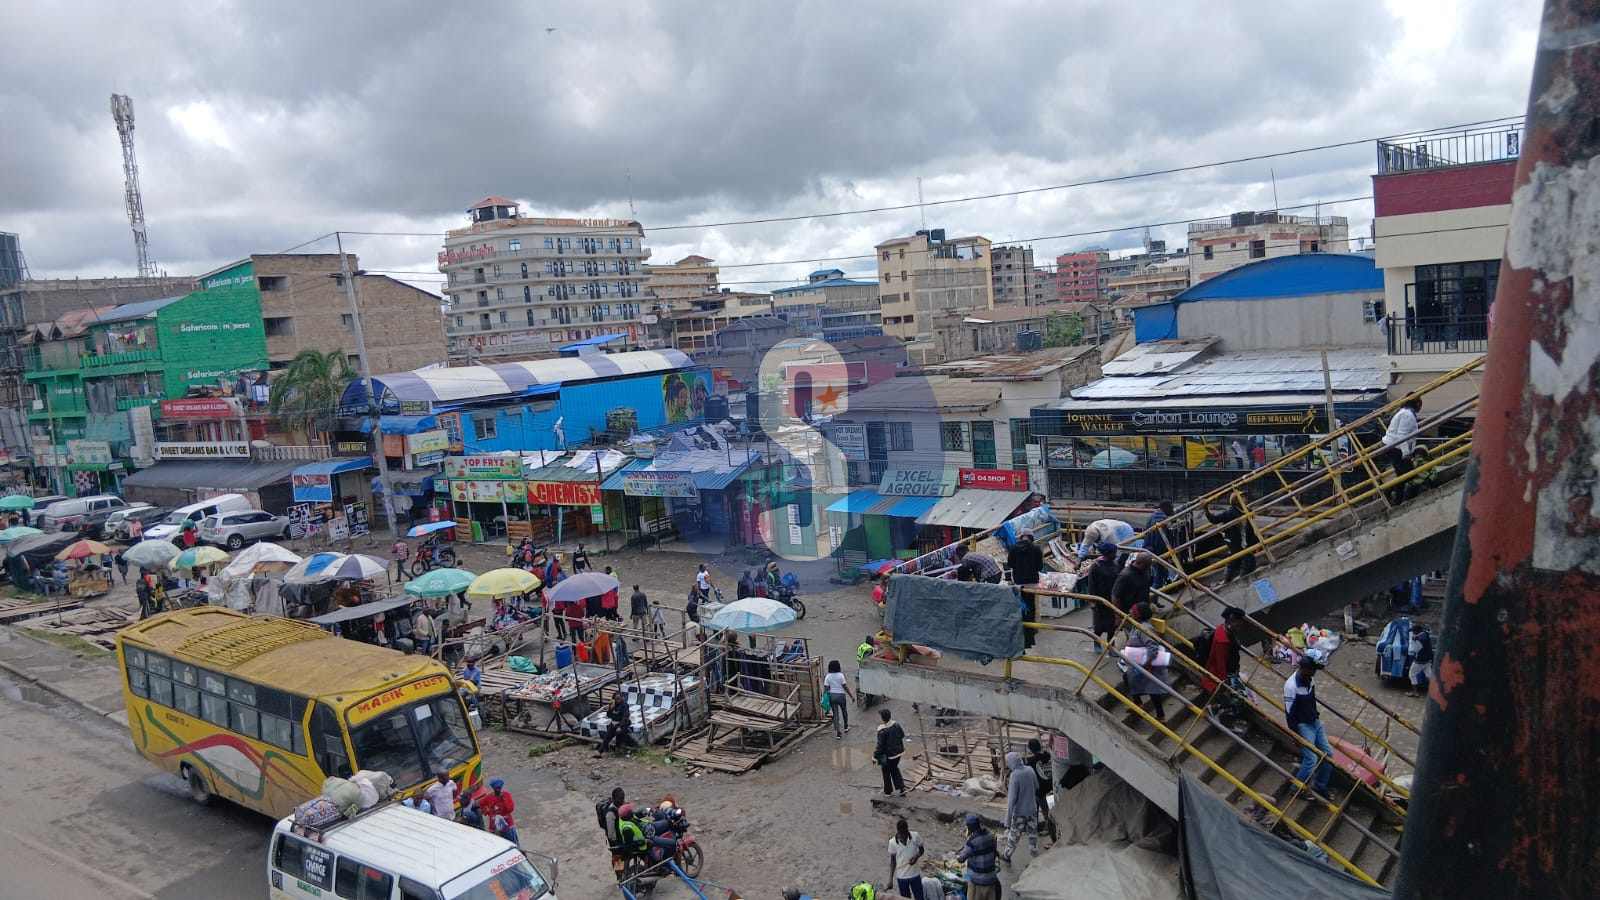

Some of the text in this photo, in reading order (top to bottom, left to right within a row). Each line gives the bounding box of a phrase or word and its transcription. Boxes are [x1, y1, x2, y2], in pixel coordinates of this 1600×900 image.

[1131, 410, 1238, 426] Carbon Lounge
[1248, 415, 1302, 423] KEEP WALKING
[1081, 422, 1125, 432] WALKER
[161, 446, 180, 455] SWEET
[181, 446, 205, 455] DREAMS
[206, 446, 218, 455] BAR
[464, 458, 481, 467] TOP
[896, 470, 934, 482] EXCEL
[885, 483, 950, 495] AGROVET
